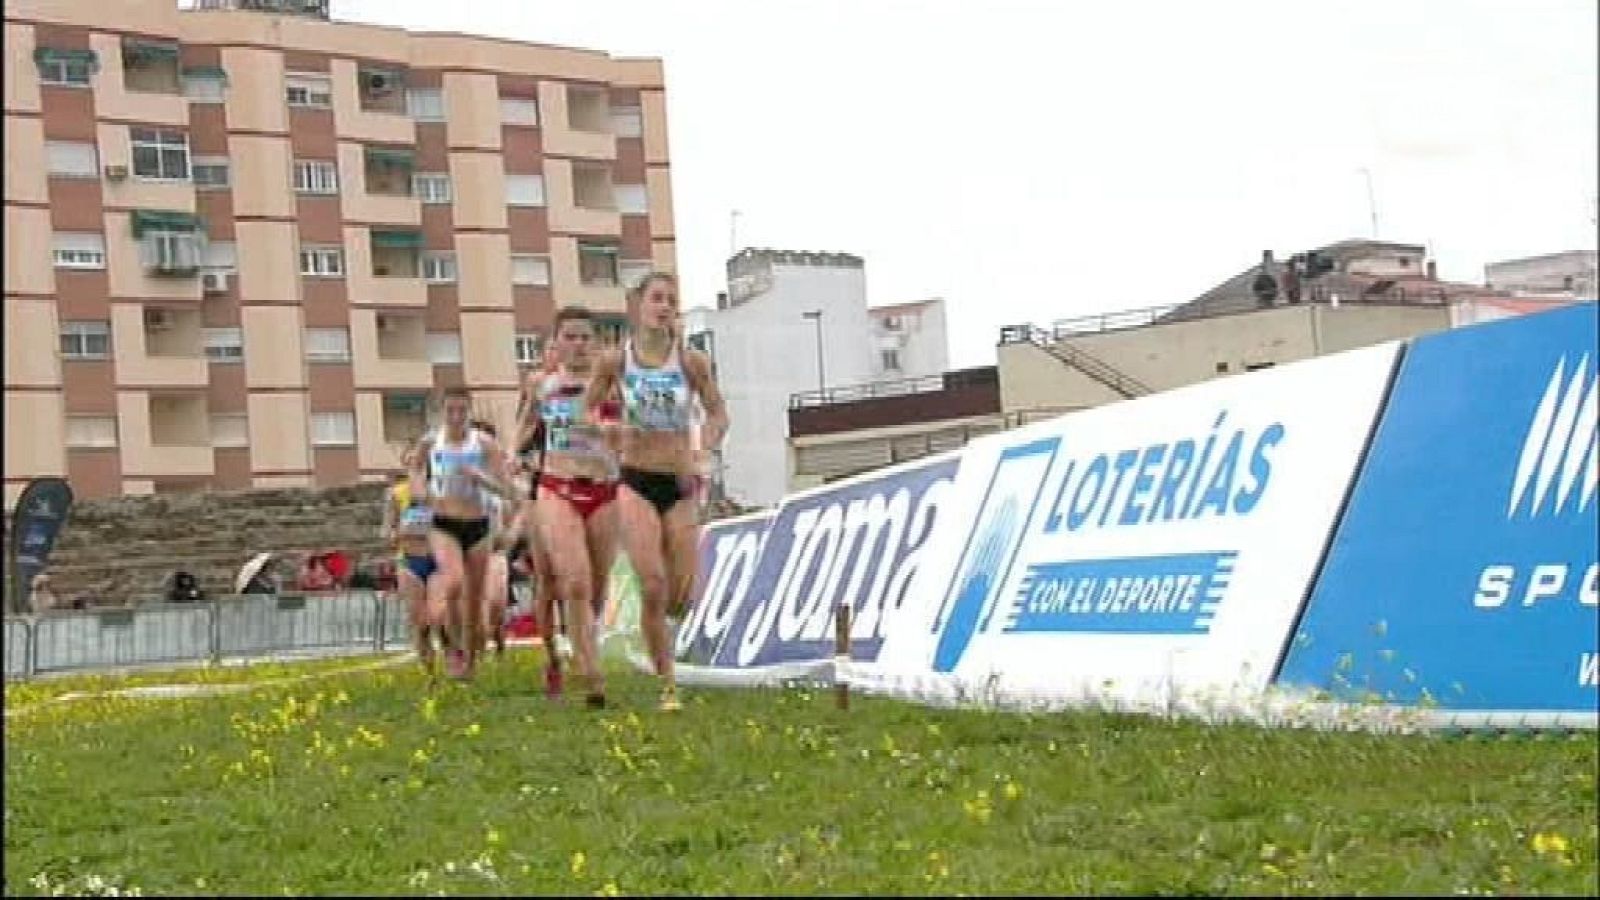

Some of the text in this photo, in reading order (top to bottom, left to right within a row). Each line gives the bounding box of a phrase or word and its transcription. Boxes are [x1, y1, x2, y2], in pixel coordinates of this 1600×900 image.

[1043, 410, 1285, 535] LOTERÍAS
[1028, 574, 1203, 614] CON EL DEPORTE
